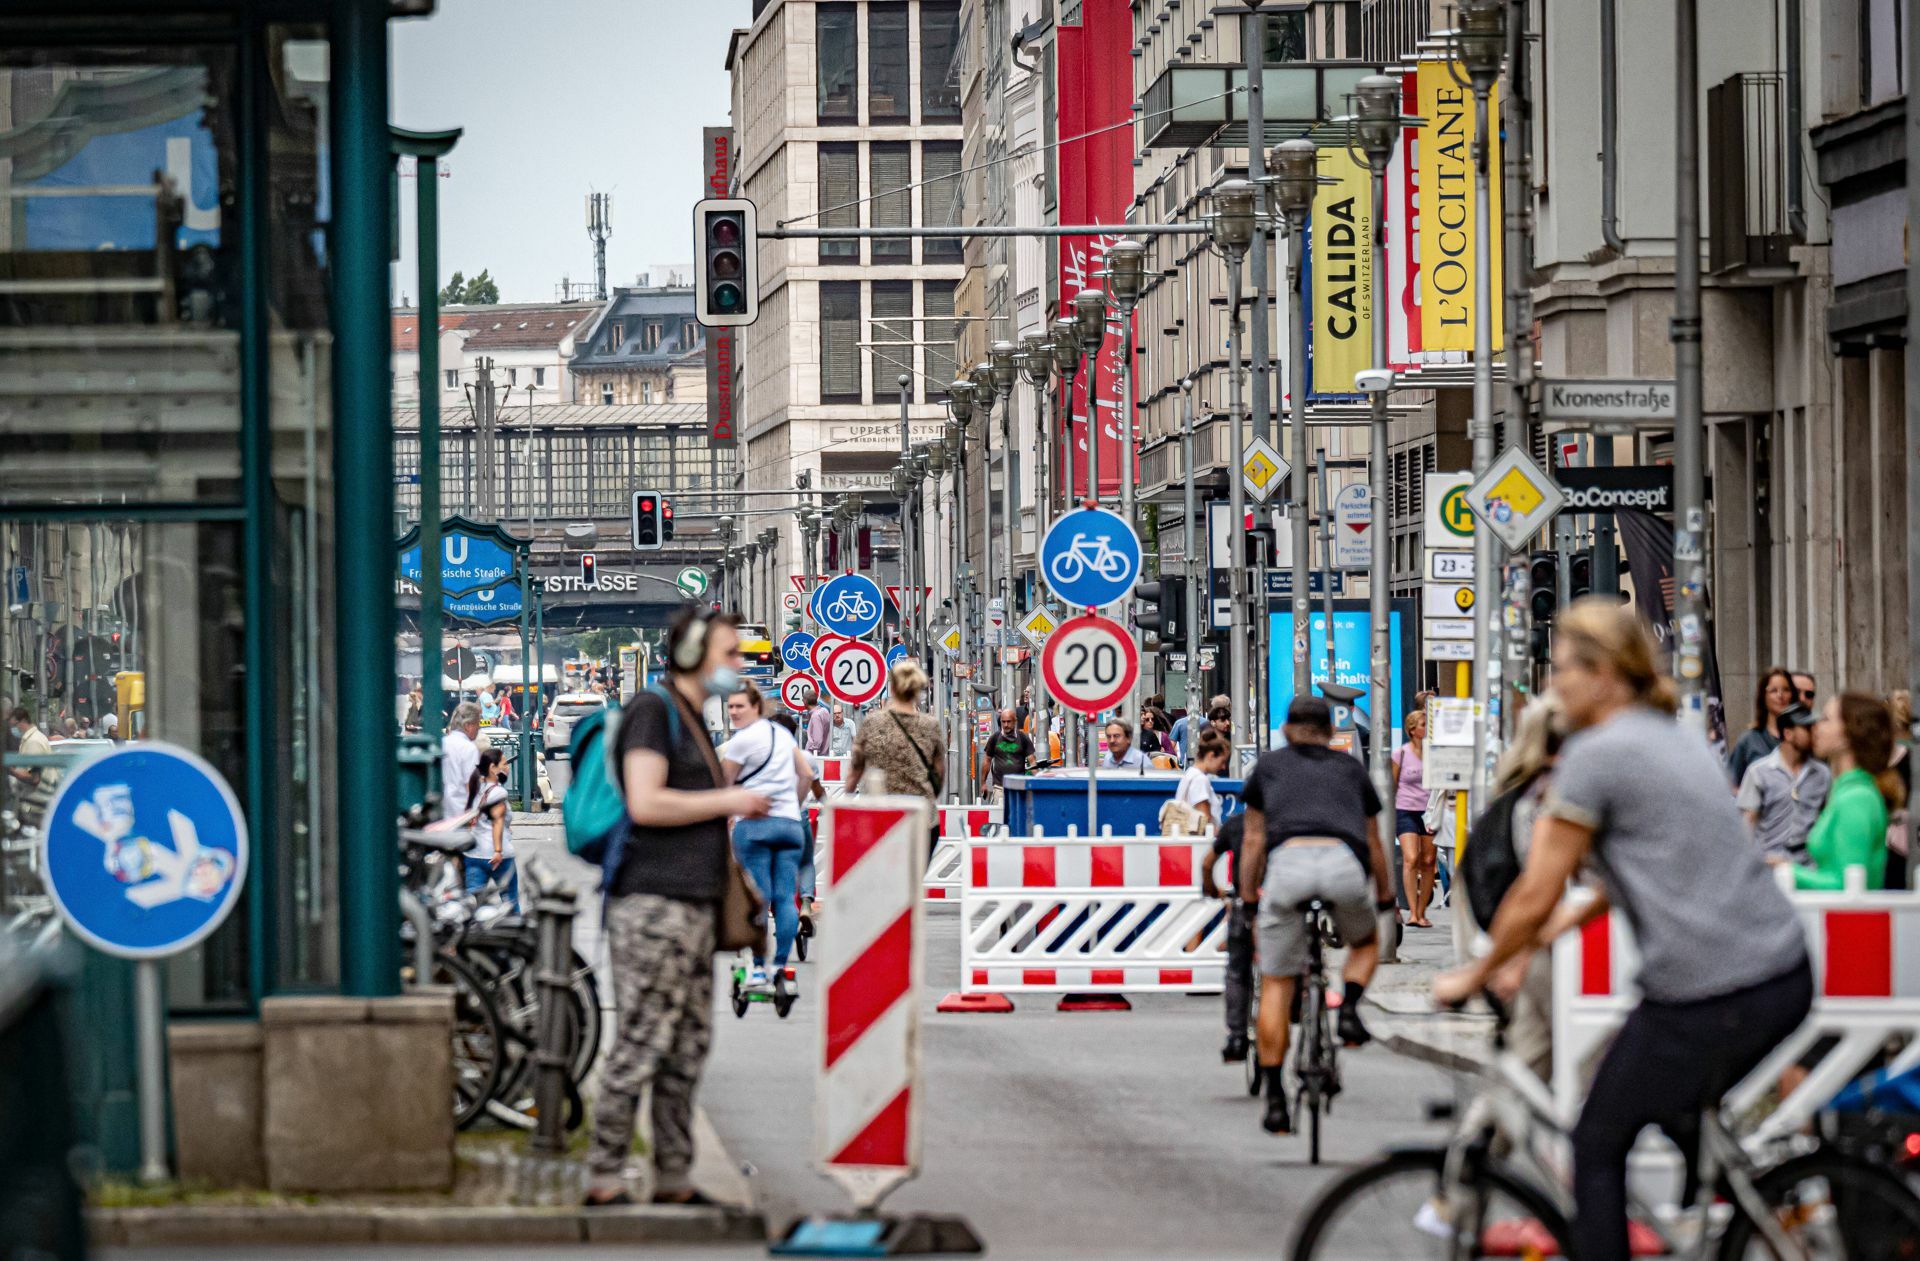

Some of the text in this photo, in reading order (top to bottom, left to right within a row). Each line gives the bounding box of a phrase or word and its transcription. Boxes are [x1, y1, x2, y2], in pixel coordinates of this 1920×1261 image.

[710, 136, 728, 200] ufhaus
[1432, 87, 1468, 327] L'OCCITANE
[1326, 197, 1358, 340] CALIDA
[1361, 216, 1371, 320] OF SWITZERLAND
[713, 337, 732, 439] Dussmann
[1552, 386, 1671, 413] Kronenstraße
[850, 426, 890, 435] UPPER
[1352, 488, 1366, 499] 30
[445, 537, 468, 565] U
[474, 567, 506, 578] Straße
[1440, 560, 1456, 573] 23
[450, 602, 522, 611] Französische Straße
[1462, 593, 1468, 603] 2
[821, 646, 832, 666] 2
[1065, 643, 1117, 685] 20
[838, 659, 872, 686] 20
[1334, 705, 1349, 728] P
